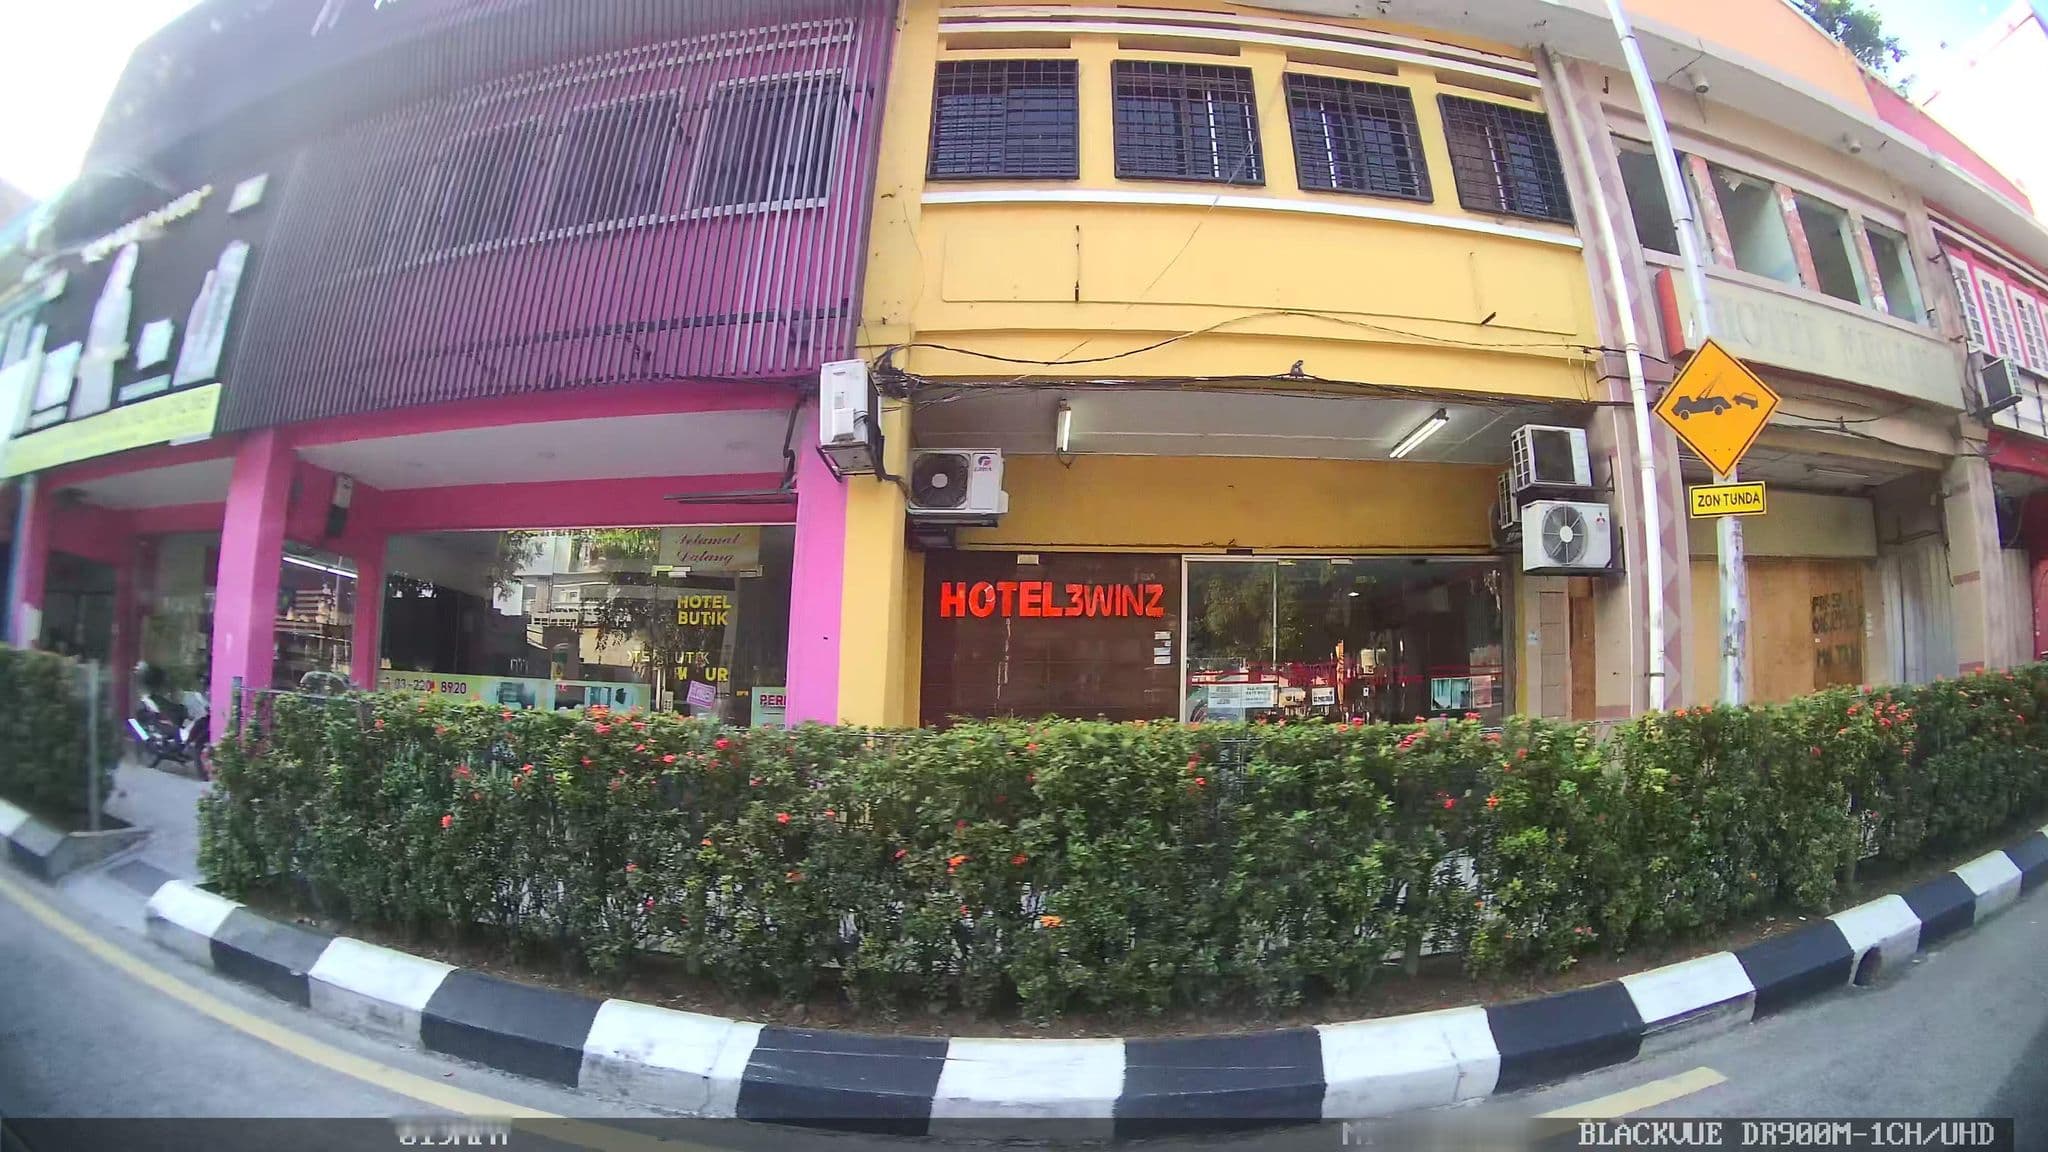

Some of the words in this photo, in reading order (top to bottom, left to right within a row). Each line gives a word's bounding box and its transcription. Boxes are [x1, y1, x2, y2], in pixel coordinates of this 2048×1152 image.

[1697, 494, 1720, 507] ZON
[1723, 492, 1761, 506] TUNDA
[677, 595, 732, 609] HOTEL
[678, 611, 729, 625] BUTIK
[441, 681, 467, 694] 8920
